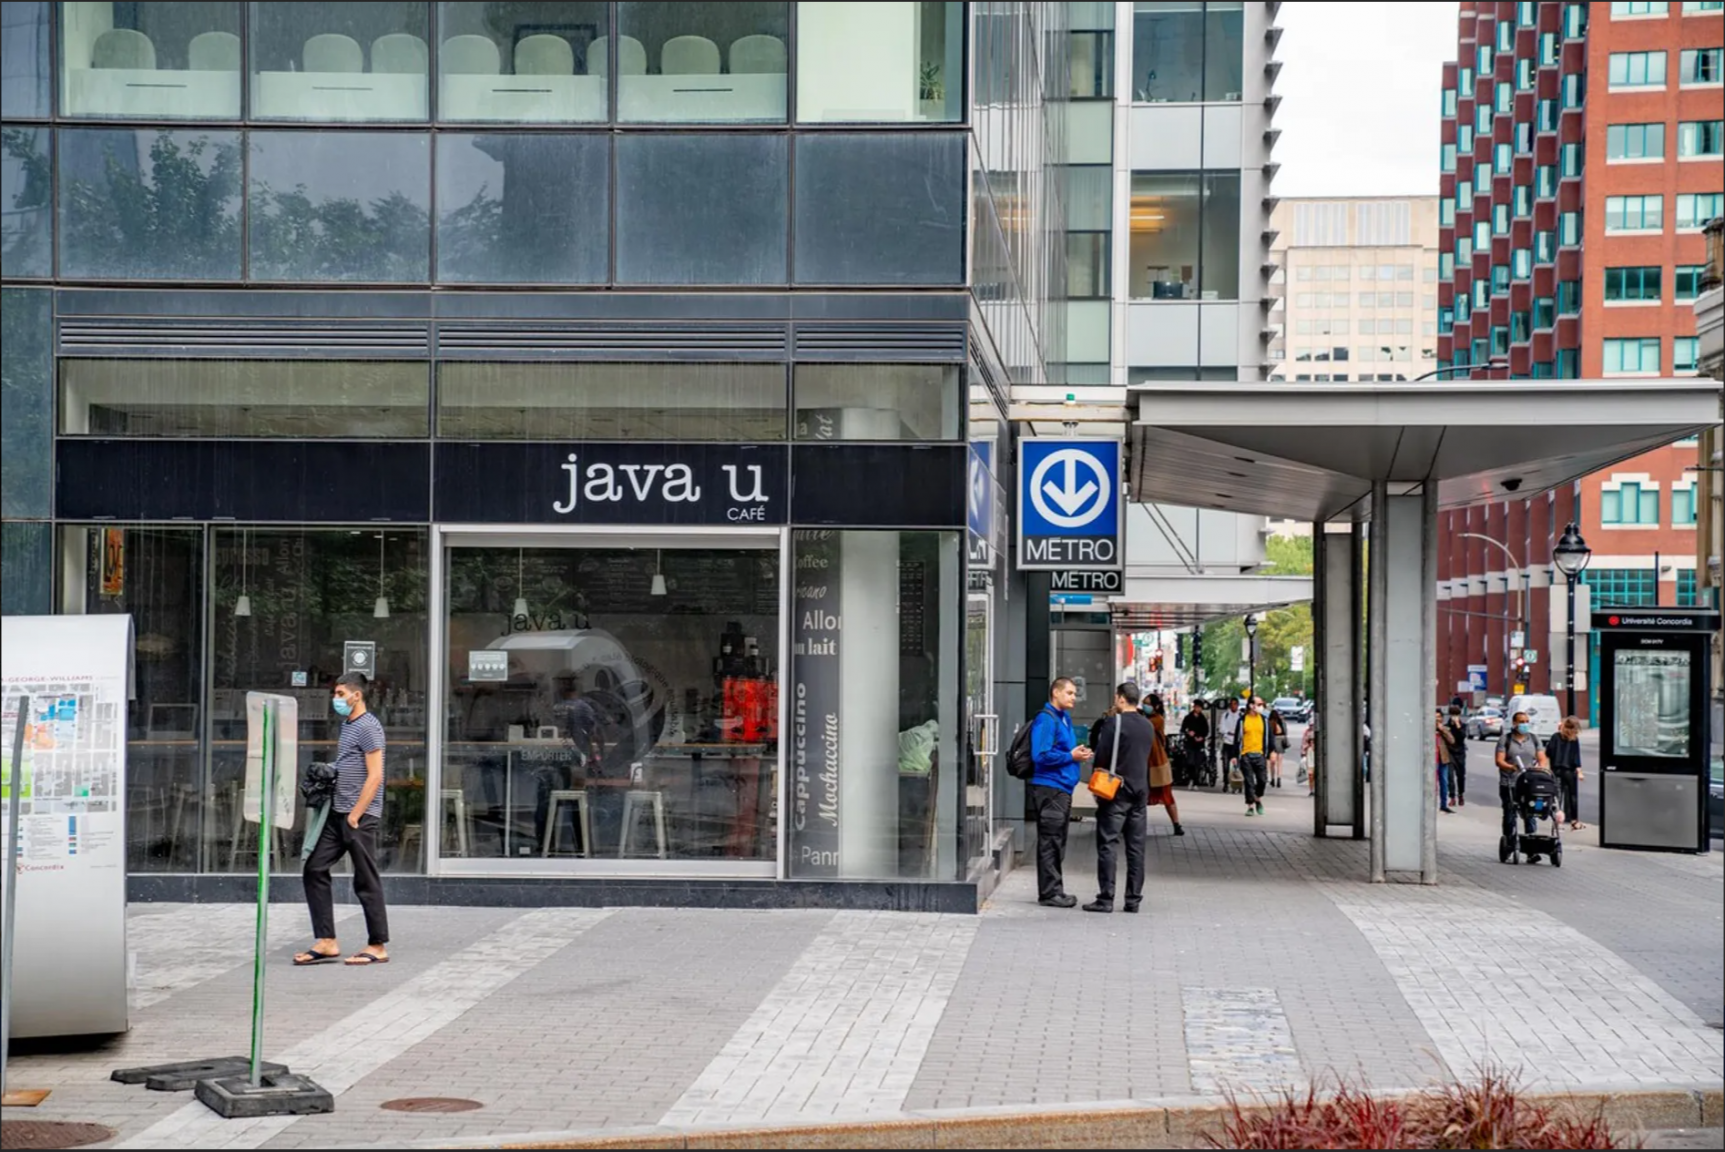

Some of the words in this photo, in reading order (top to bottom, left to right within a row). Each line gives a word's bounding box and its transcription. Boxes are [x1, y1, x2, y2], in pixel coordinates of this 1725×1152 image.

[553, 453, 701, 514] java
[722, 464, 769, 503] u
[727, 505, 766, 521] CAFÉ
[795, 554, 829, 569] offee
[501, 611, 566, 636] java
[1621, 617, 1656, 625] Université
[1656, 618, 1693, 626] Concordia
[808, 637, 838, 656] lait
[794, 682, 810, 832] Cappuccino
[818, 711, 839, 827] Mochaccino
